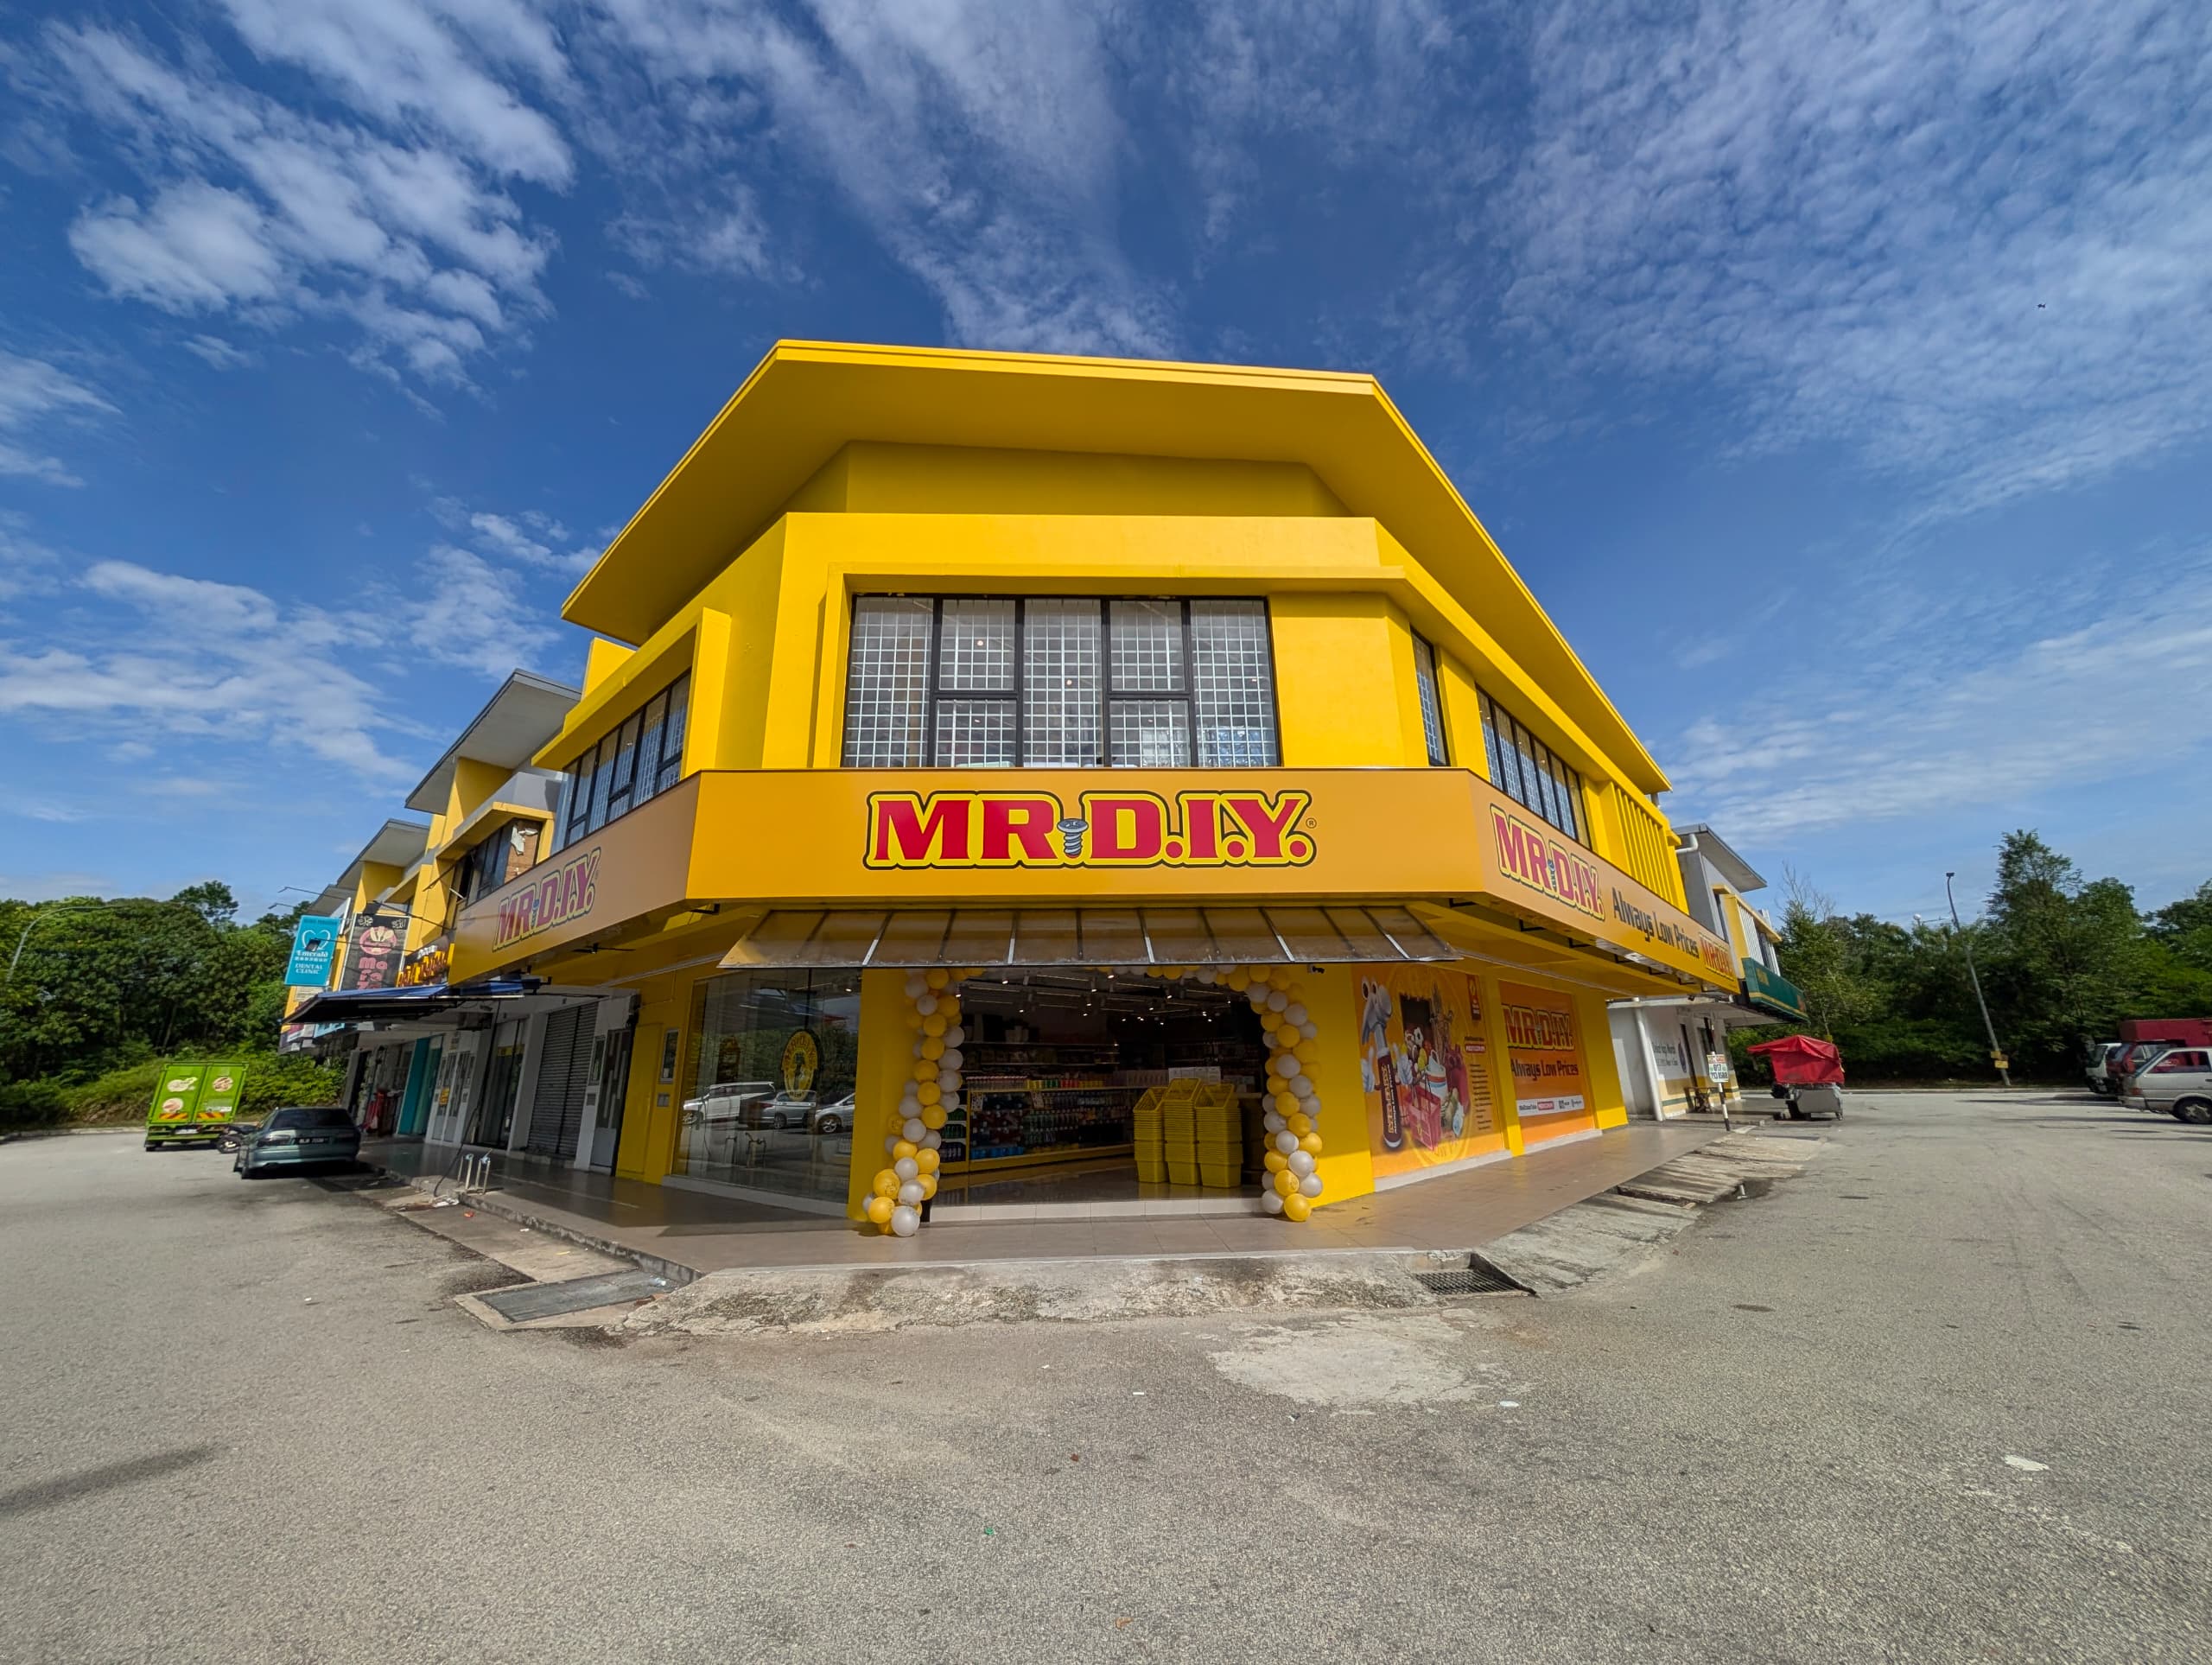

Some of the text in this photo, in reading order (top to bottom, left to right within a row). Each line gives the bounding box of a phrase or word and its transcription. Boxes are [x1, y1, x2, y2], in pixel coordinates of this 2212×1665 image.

[1611, 887, 1700, 959] Always Low Prices
[1510, 1058, 1580, 1081] Always Low Prices
